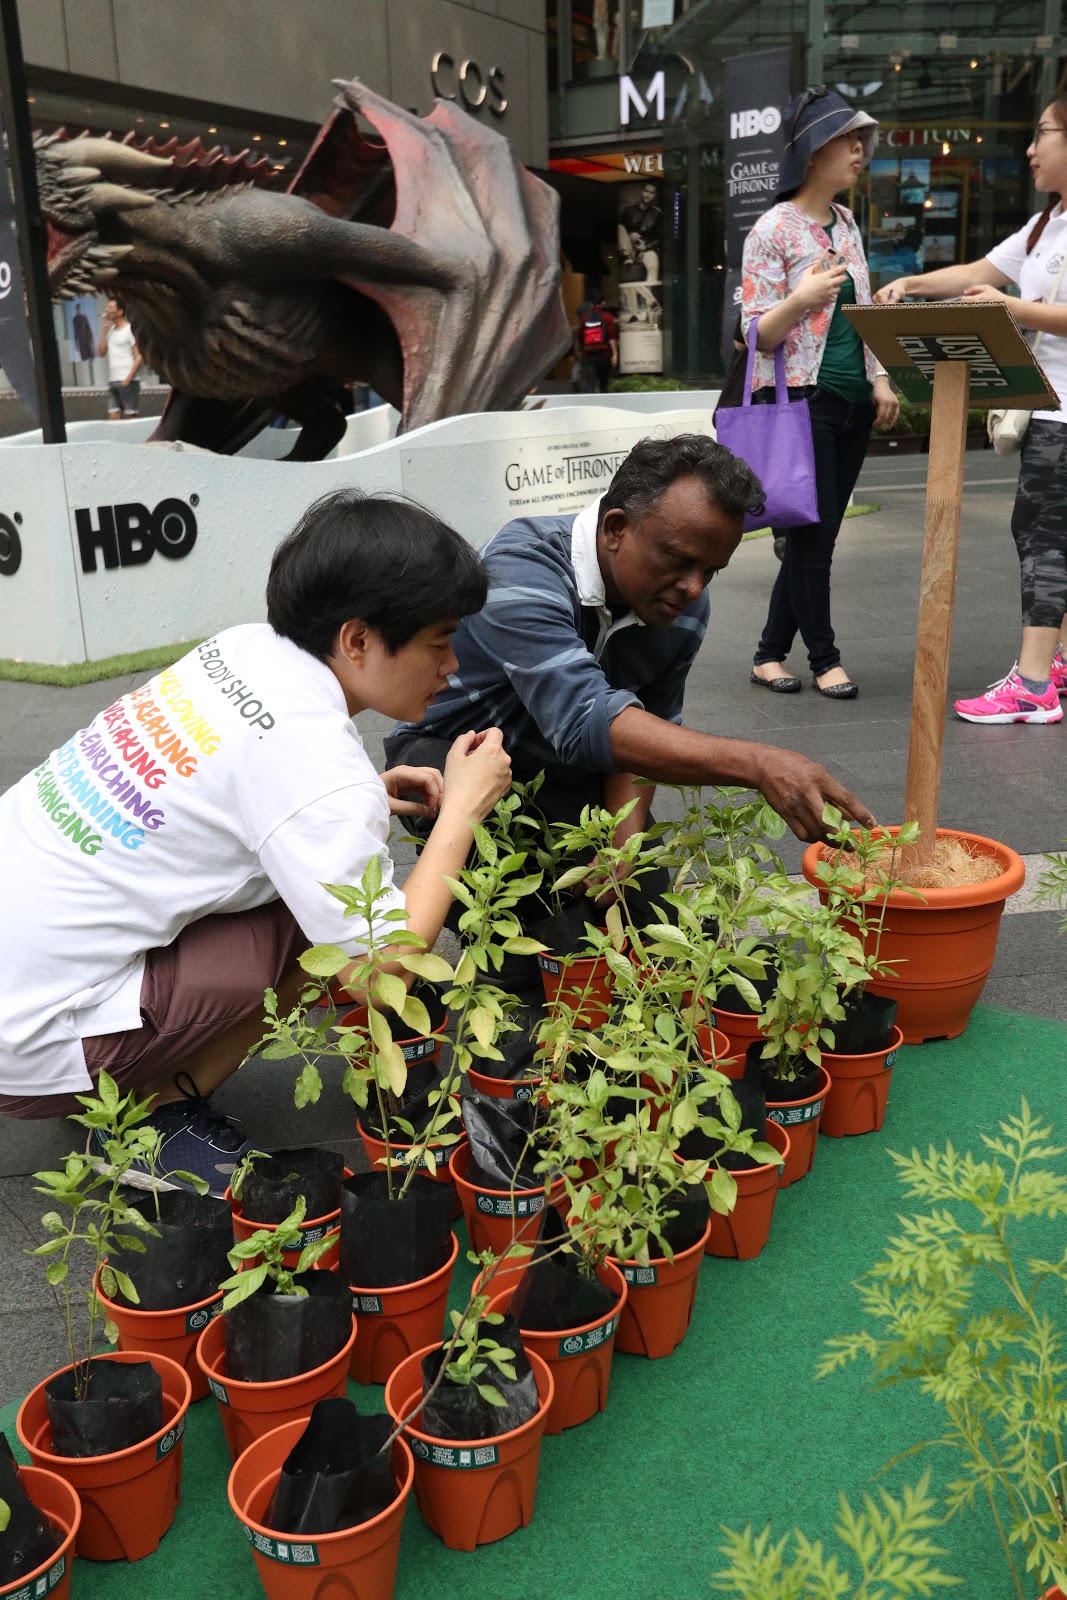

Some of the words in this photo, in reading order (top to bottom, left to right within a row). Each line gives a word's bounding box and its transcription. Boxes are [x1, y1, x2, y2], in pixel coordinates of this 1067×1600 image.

[432, 52, 508, 117] COS
[730, 106, 782, 139] HBO
[730, 161, 768, 180] GAME
[768, 162, 780, 172] OF
[505, 463, 553, 491] GAME
[555, 466, 566, 480] OF
[509, 498, 530, 507] STREAM
[75, 497, 198, 573] HBO
[200, 648, 235, 686] BODY
[166, 689, 221, 756] LOVING
[37, 771, 105, 856] CHANGING
[59, 759, 146, 850] BANNING
[80, 733, 166, 830] ENRICHING
